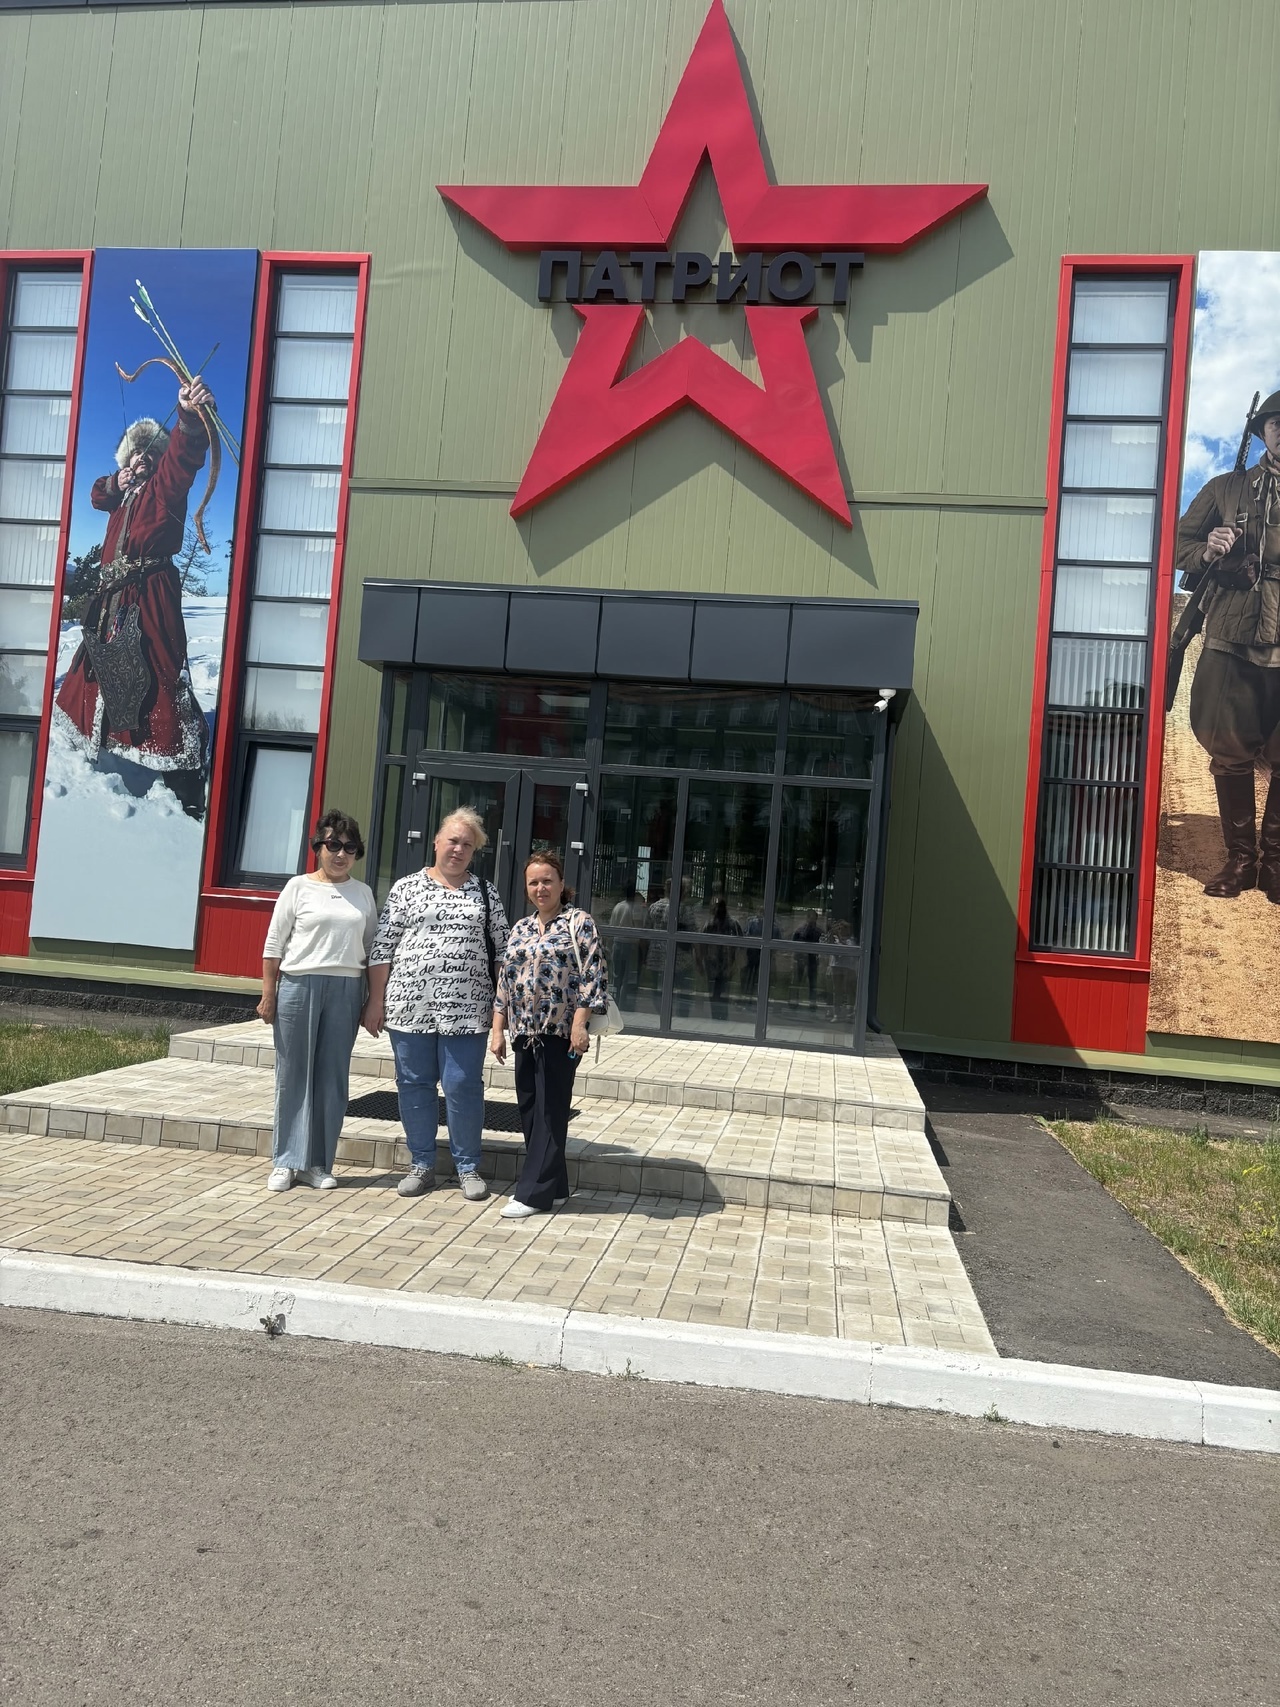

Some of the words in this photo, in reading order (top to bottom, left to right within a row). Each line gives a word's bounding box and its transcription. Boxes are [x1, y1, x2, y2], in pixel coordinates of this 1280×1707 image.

[538, 249, 865, 305] ПАТРИОТ
[436, 909, 474, 921] Cruise
[422, 949, 479, 960] Elisabetta
[420, 963, 435, 976] de
[439, 960, 469, 973] tout
[433, 987, 467, 999] Cruise
[424, 1000, 478, 1012] Elisabetta
